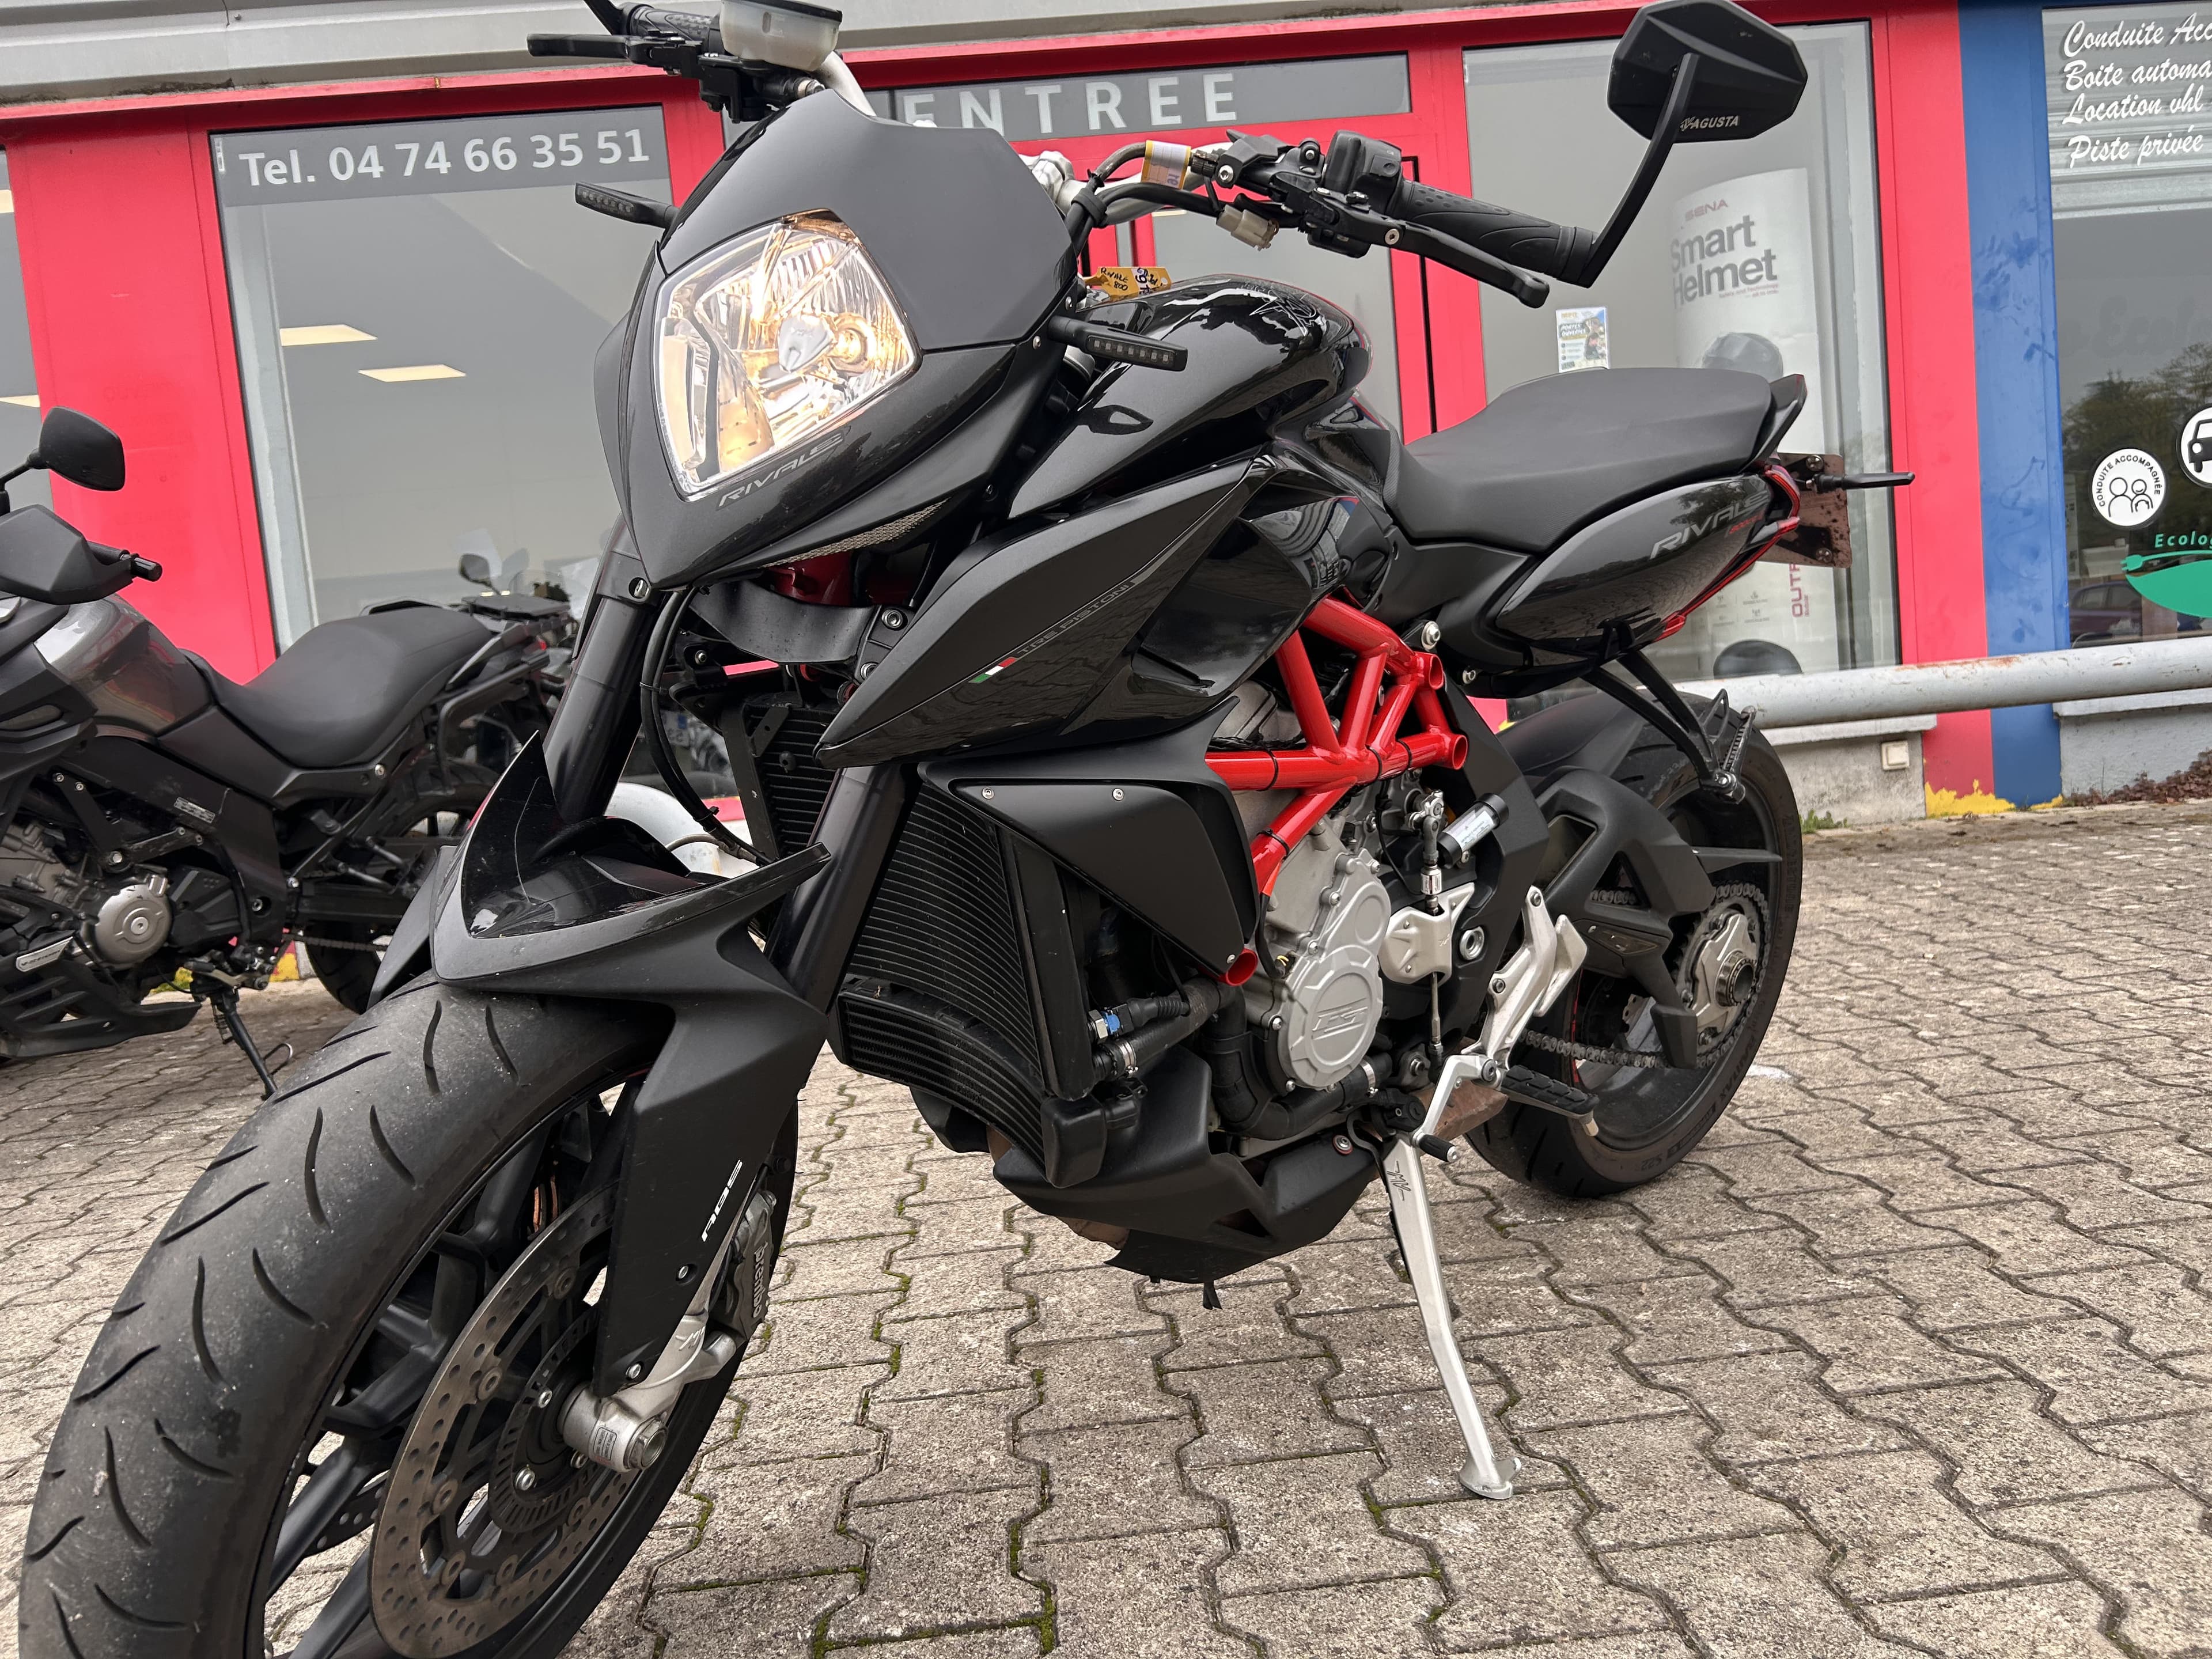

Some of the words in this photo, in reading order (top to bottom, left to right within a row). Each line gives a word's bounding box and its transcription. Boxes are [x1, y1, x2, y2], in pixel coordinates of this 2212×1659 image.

[2064, 20, 2164, 58] Conduite
[2062, 93, 2162, 124] Location
[2169, 82, 2203, 113] vhl
[2064, 59, 2124, 90] Boite
[903, 73, 1237, 136] ENTREE
[1690, 115, 1739, 129] AGUSTA
[238, 149, 315, 186] Tel.
[329, 145, 384, 181] 04
[395, 141, 451, 176] 74
[464, 137, 517, 172] 66
[530, 133, 583, 168] 35
[597, 128, 649, 165] 51
[2068, 135, 2130, 169] Piste
[2137, 124, 2203, 166] privée
[1685, 199, 1728, 221] SENA
[1671, 215, 1756, 274] Smart
[1673, 248, 1777, 309] Helmet
[719, 433, 843, 507] RIVALE
[2096, 463, 2113, 507] CONDUITE
[2115, 454, 2162, 495] ACCOMPAGNÉE
[1650, 490, 1770, 559] RIVALE
[2155, 531, 2212, 549] Ecolo
[1017, 630, 1058, 654] TRE
[1059, 584, 1129, 629] PISTONI
[701, 1159, 743, 1242] ABS
[753, 1240, 768, 1318] brembo
